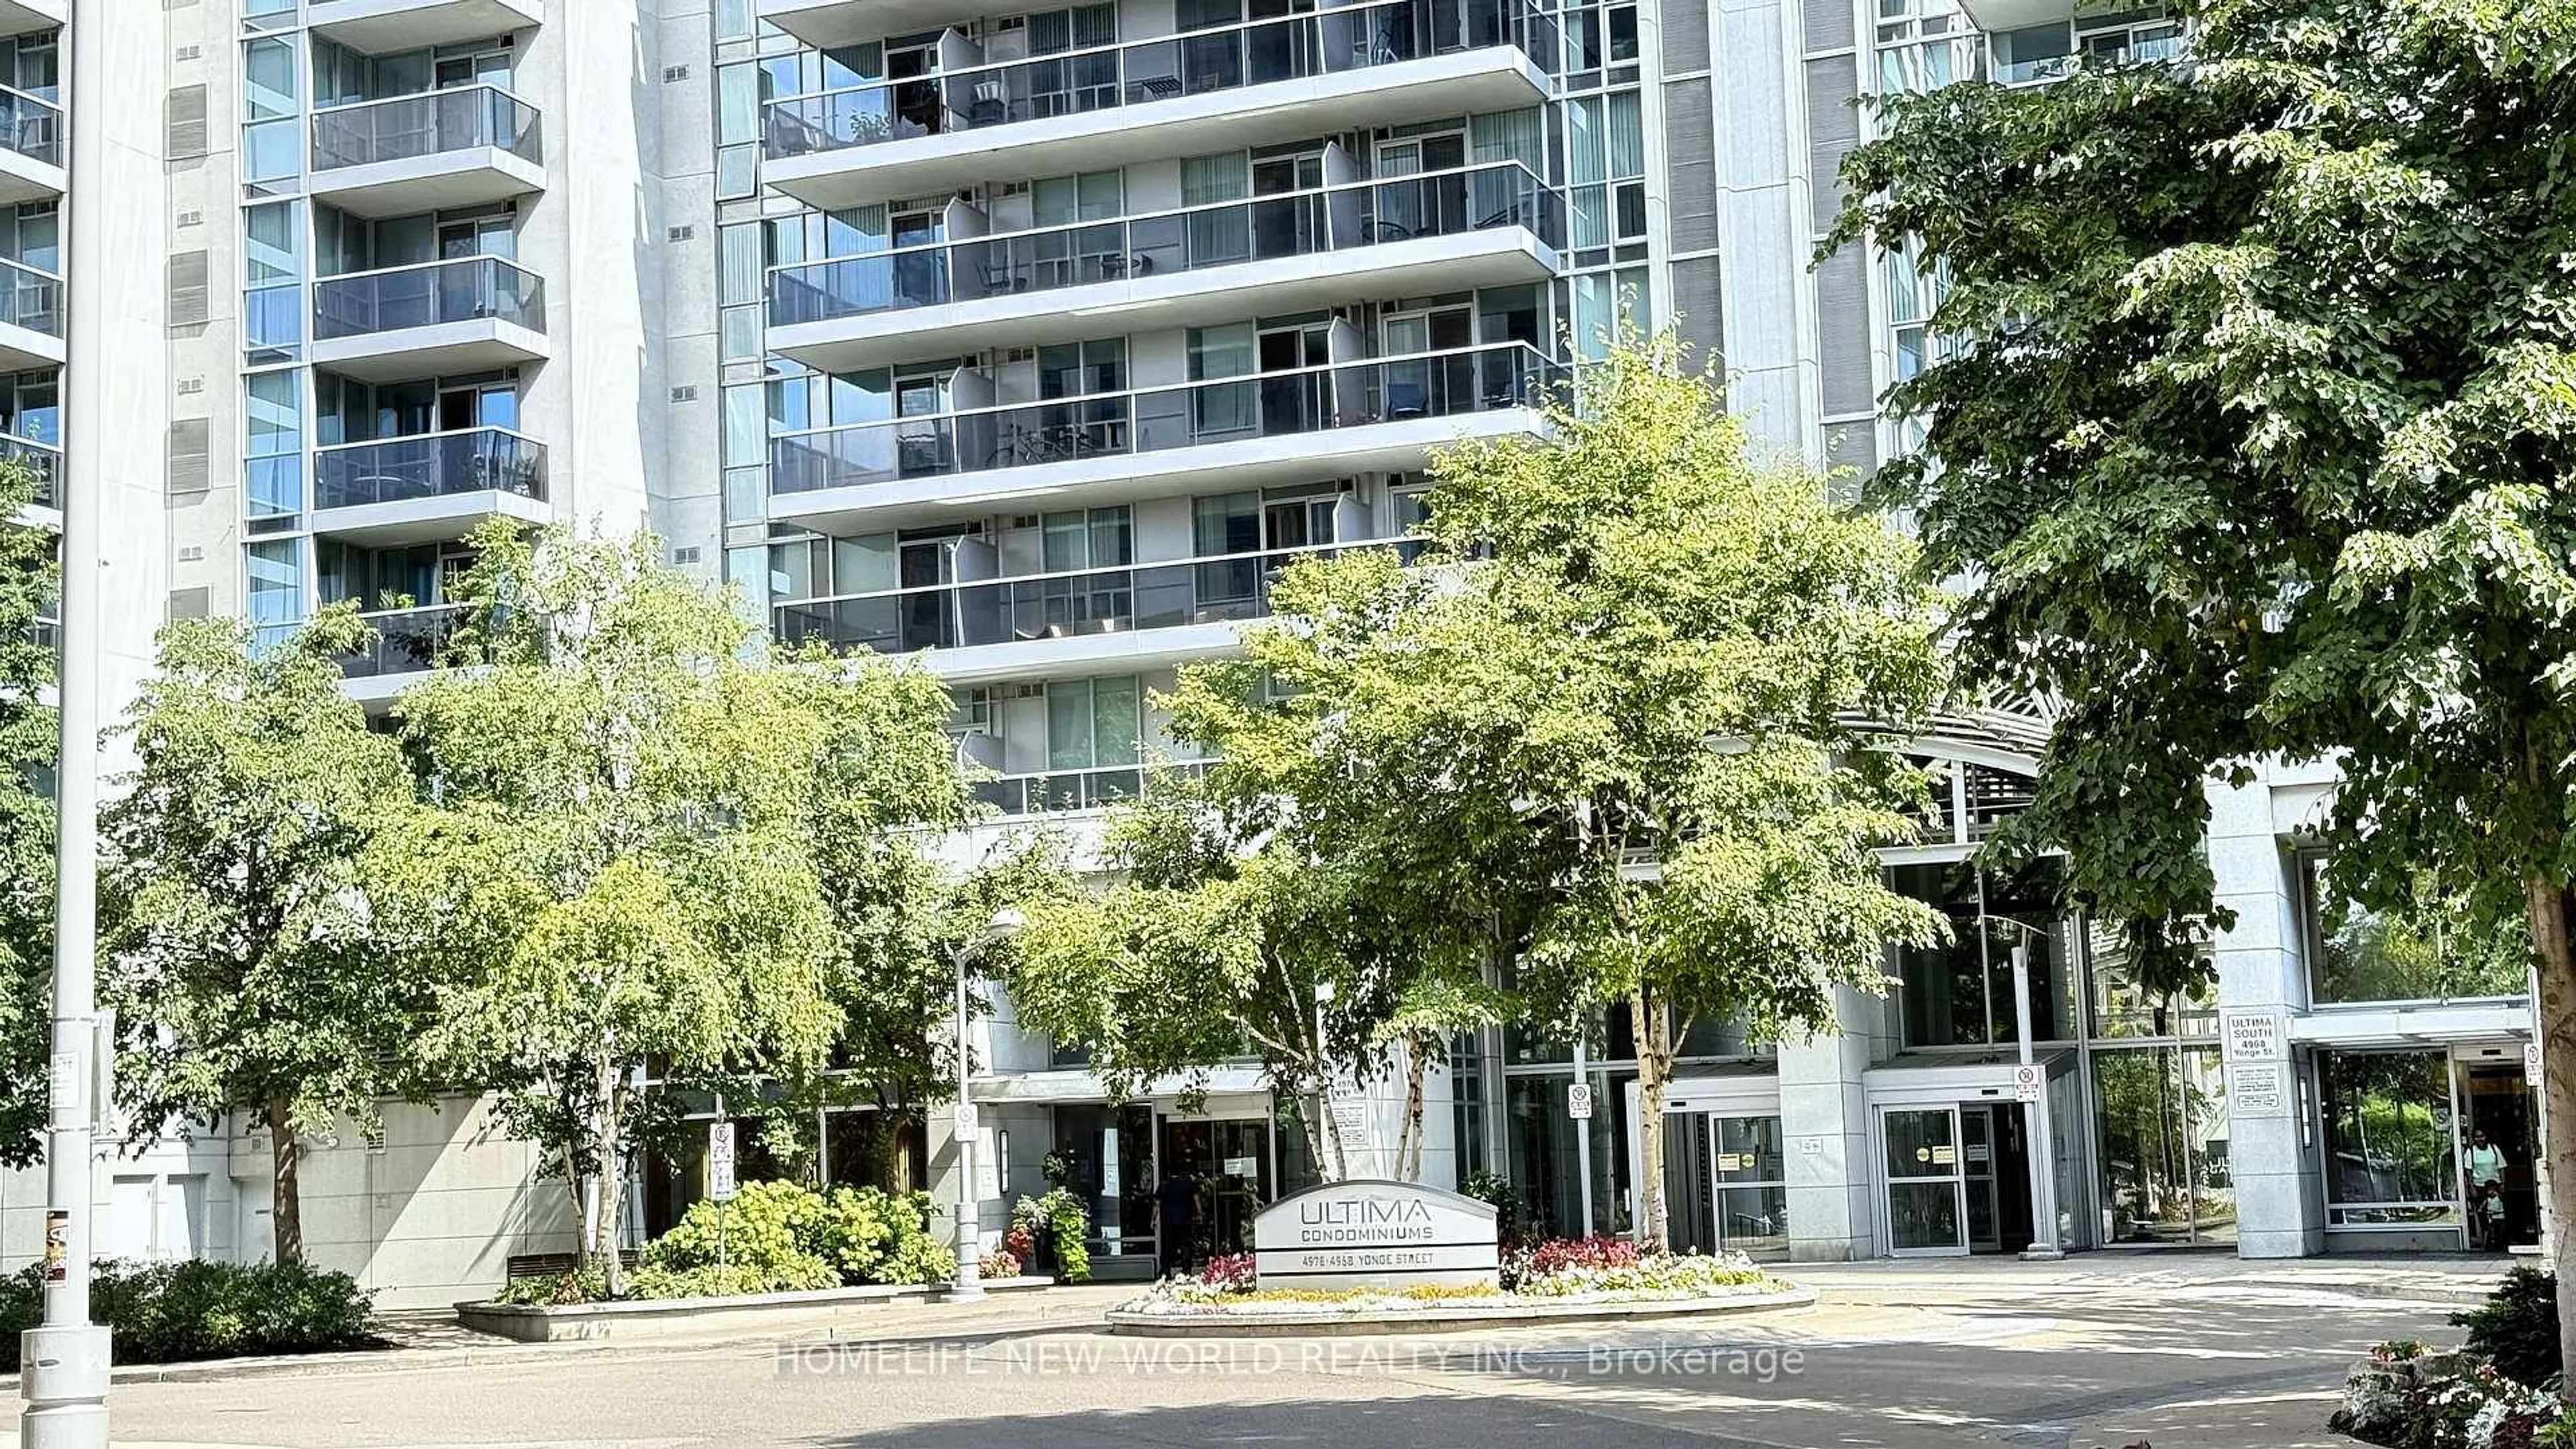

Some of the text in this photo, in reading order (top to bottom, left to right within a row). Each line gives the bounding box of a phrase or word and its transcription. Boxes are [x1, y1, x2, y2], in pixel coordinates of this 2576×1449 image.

[2232, 1018, 2272, 1027] ULTIMA
[2234, 1028, 2272, 1038] SOUTH
[2242, 1040, 2265, 1048] 4968
[1300, 1199, 1432, 1224] ULTIMA
[1301, 1226, 1434, 1242] CONDOMINIUMS
[1358, 1254, 1393, 1266] YONGE
[1395, 1253, 1434, 1265] STREET
